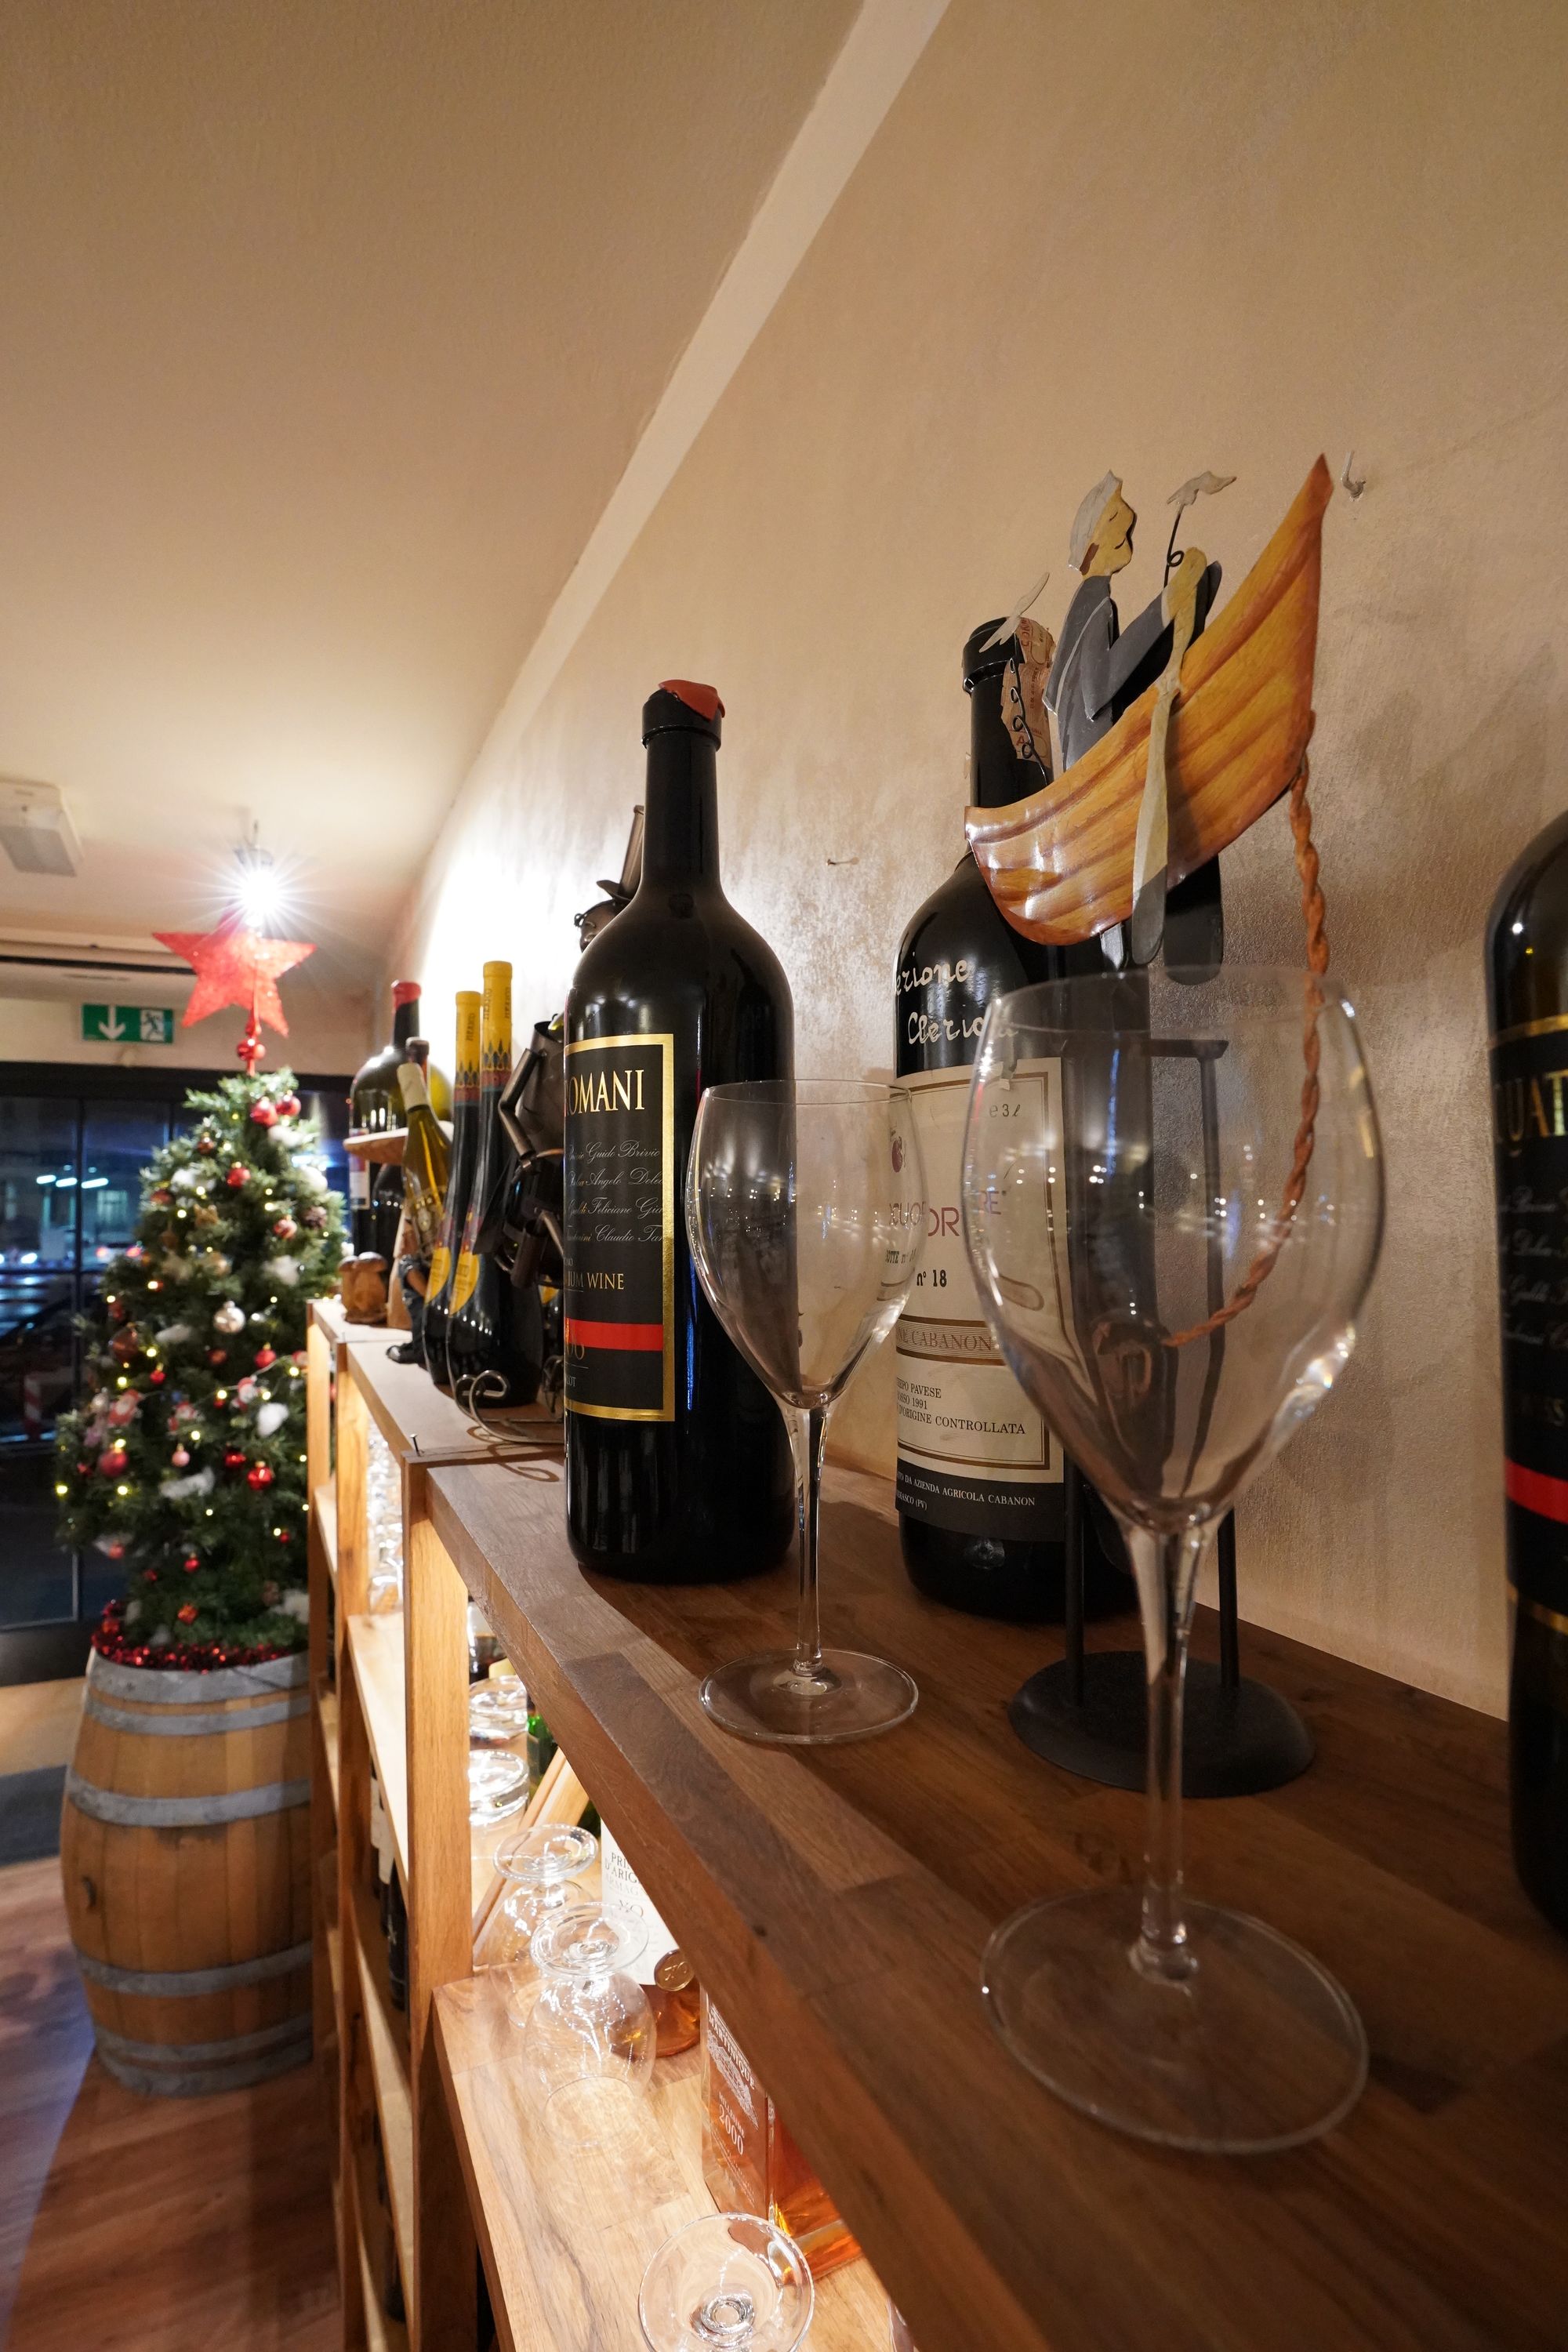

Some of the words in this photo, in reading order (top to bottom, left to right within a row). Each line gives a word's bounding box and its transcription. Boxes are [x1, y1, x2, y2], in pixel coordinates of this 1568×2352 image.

[585, 1142, 616, 1164] Guido
[617, 1139, 660, 1158] Brivio
[586, 1168, 625, 1190] Angelo
[588, 1196, 632, 1215] Feliciano
[595, 1224, 635, 1242] Claudio
[587, 1272, 625, 1290] WINE
[933, 1269, 947, 1287] 18
[910, 1383, 942, 1399] PAVESE
[912, 1396, 927, 1410] 1991
[935, 1415, 1026, 1435] CONTROLLATA
[913, 1478, 940, 1494] AZIENDA
[942, 1486, 985, 1502] AGRICOLA
[988, 1494, 1036, 1506] CABANON
[915, 1498, 927, 1511] (PV)
[611, 1852, 630, 1870] PRI
[604, 1857, 641, 1884] D'ARIG
[719, 2104, 743, 2156] 2000
